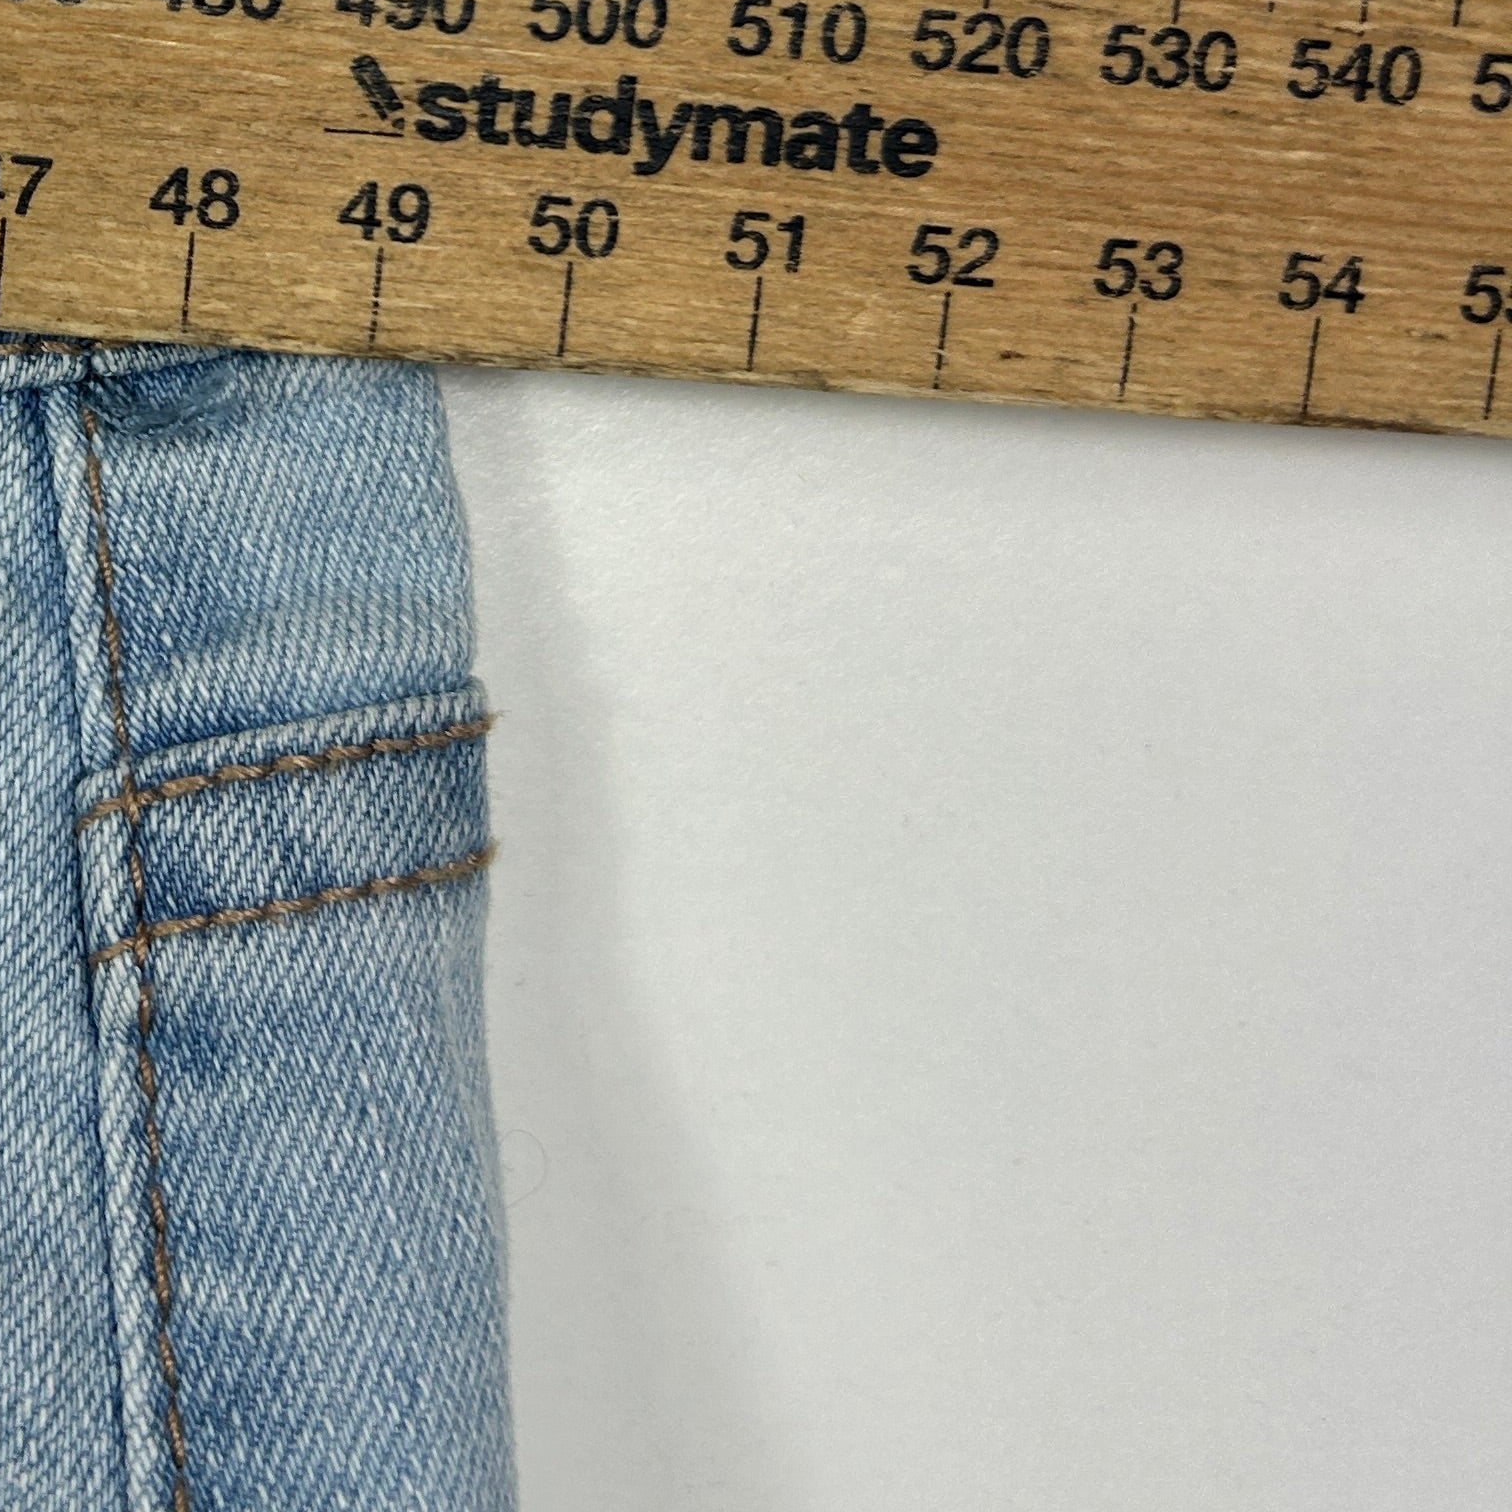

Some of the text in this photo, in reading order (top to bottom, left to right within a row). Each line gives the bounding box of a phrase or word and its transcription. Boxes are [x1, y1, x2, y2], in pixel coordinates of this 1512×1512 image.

[909, 9, 1052, 79] 520
[1099, 23, 1238, 92] 530
[1286, 37, 1424, 106] 540
[414, 74, 940, 179] studymate
[149, 167, 240, 231] 48
[336, 182, 432, 243] 49
[527, 194, 619, 258] 50
[725, 210, 808, 273] 51
[904, 224, 1001, 288] 52
[1092, 238, 1185, 302] 53
[1278, 252, 1368, 316] 54
[1459, 262, 1512, 325] 5
